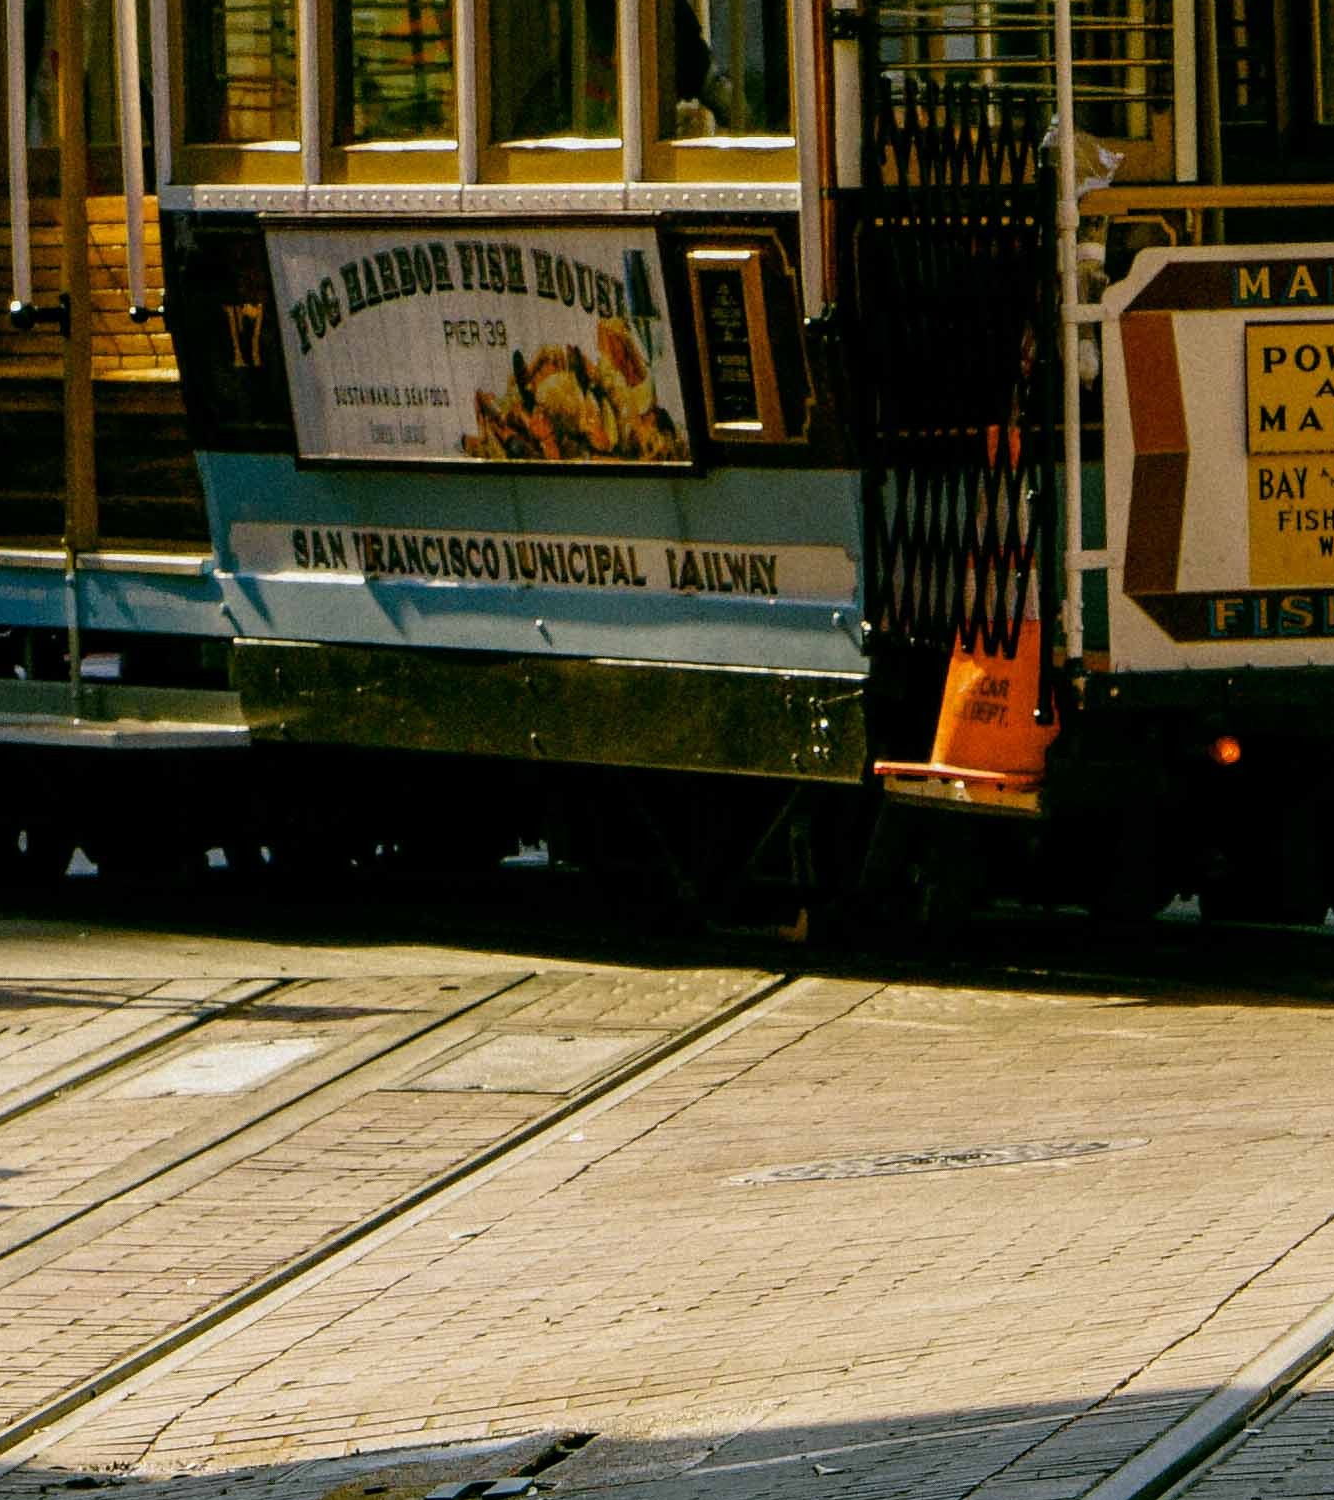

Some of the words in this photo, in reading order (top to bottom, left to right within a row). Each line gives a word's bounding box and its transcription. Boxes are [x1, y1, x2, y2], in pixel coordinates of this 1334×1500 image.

[288, 277, 340, 355] FOG
[340, 240, 454, 315] HARBOR
[454, 240, 528, 294] FISH
[223, 302, 265, 368] 17
[443, 319, 481, 346] PIER
[486, 319, 508, 346] 39
[1259, 467, 1308, 500] BAY
[293, 528, 348, 570] SAN
